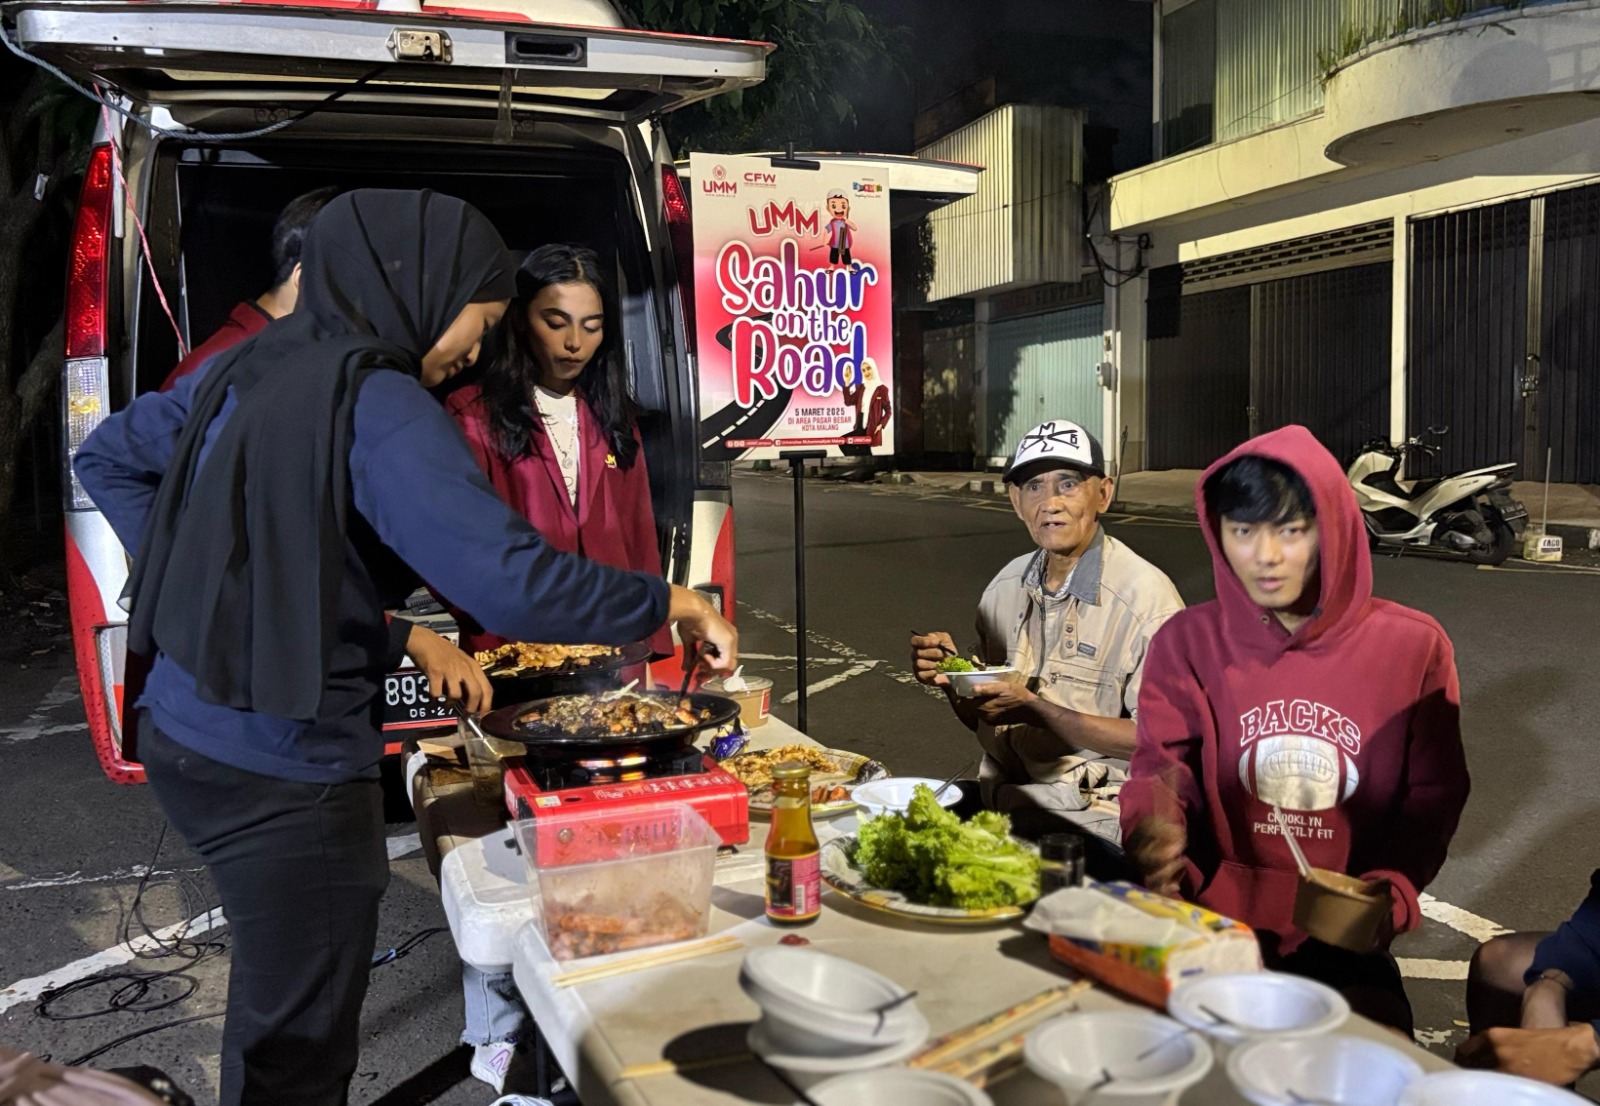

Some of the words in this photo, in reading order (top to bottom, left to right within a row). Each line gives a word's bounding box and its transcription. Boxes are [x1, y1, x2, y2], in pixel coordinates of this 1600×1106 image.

[703, 180, 737, 194] UMM
[743, 172, 776, 183] CFW
[748, 200, 819, 236] UMM
[718, 240, 876, 311] Sahur
[775, 312, 804, 334] on
[808, 309, 850, 342] the
[734, 319, 865, 405] Road
[795, 408, 800, 416] 5
[802, 408, 825, 416] MARET
[827, 407, 845, 415] 2025
[813, 416, 831, 424] PASAR
[385, 675, 447, 706] 893
[1240, 699, 1361, 755] BACKS
[1317, 829, 1335, 839] FIT
